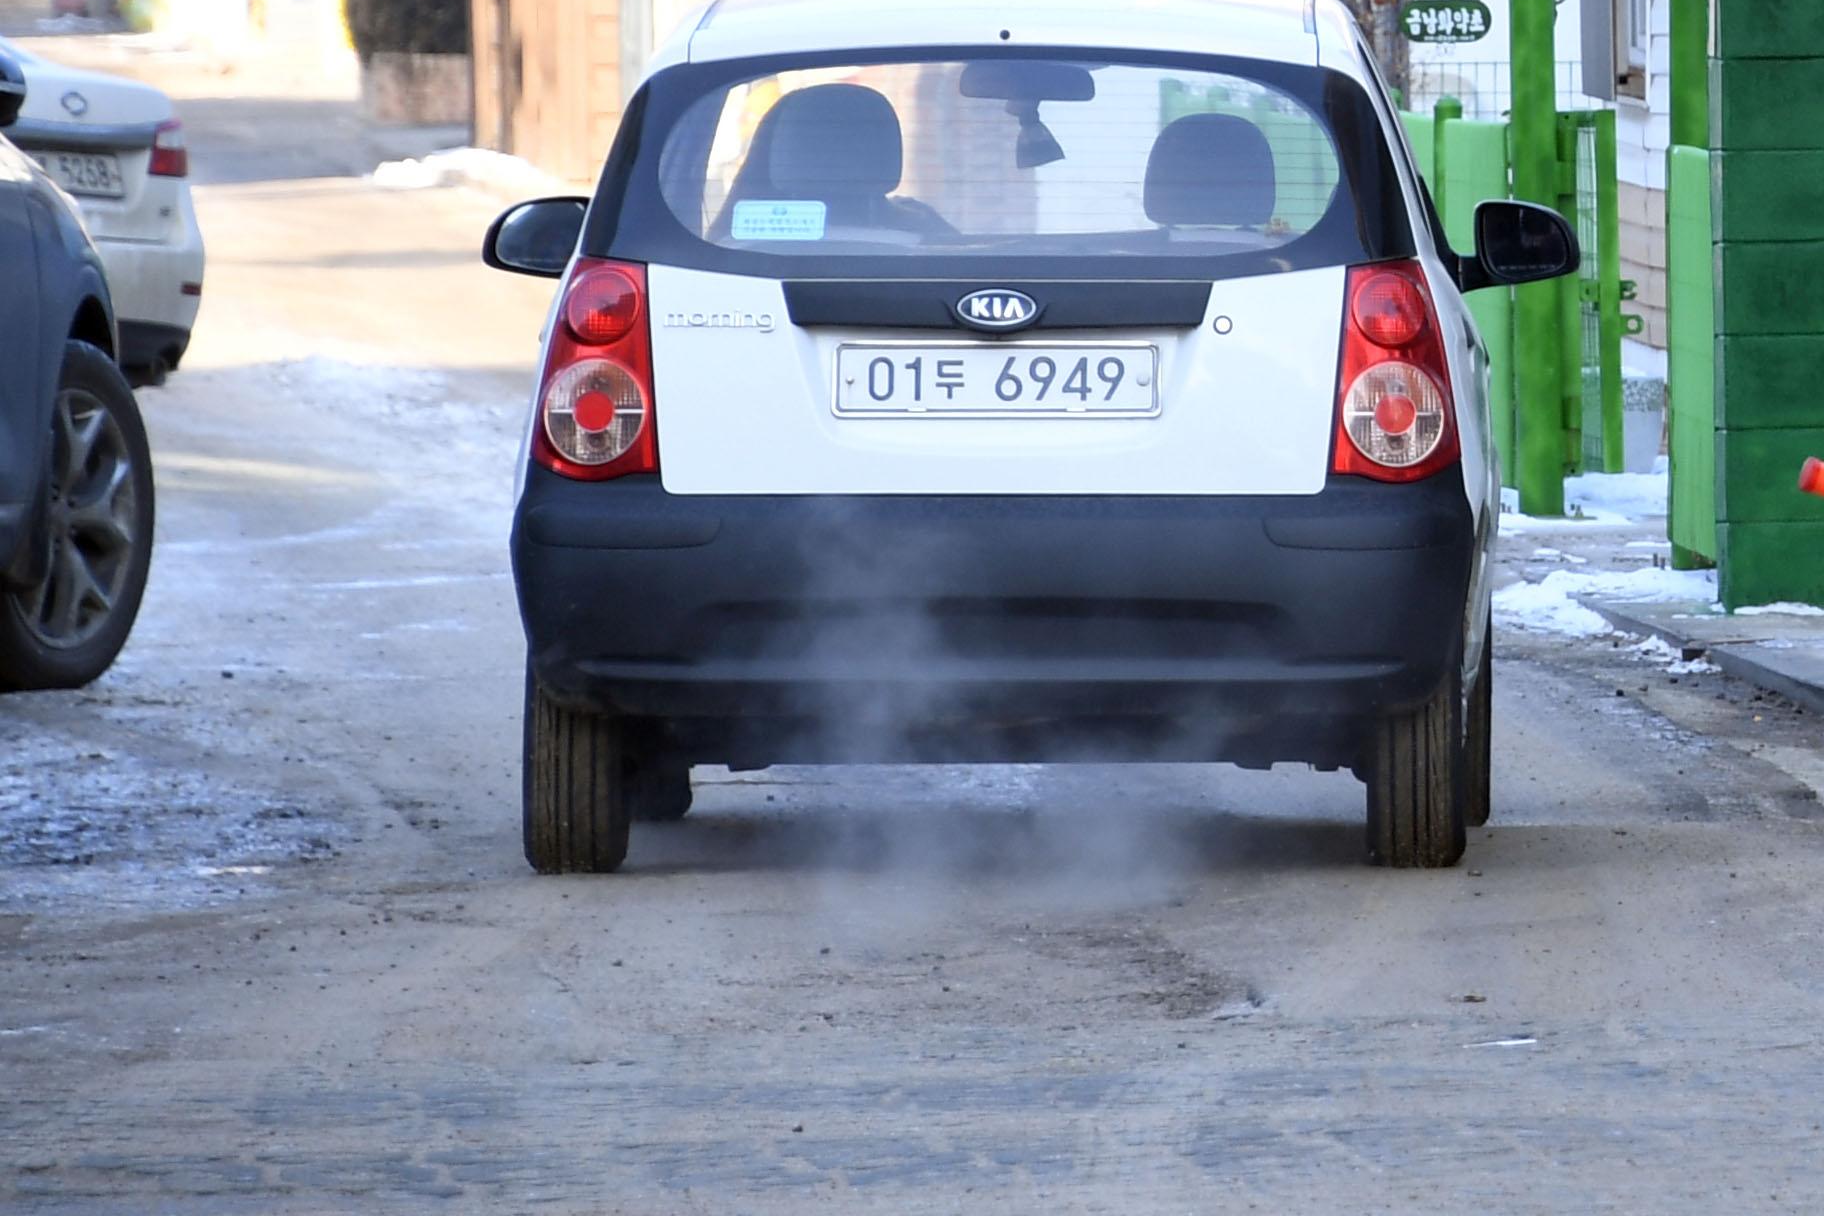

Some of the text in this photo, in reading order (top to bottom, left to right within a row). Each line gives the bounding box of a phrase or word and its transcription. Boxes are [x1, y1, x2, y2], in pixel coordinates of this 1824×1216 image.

[970, 297, 1025, 319] KIA
[663, 310, 776, 334] morning
[868, 356, 1126, 402] 01두 6949
